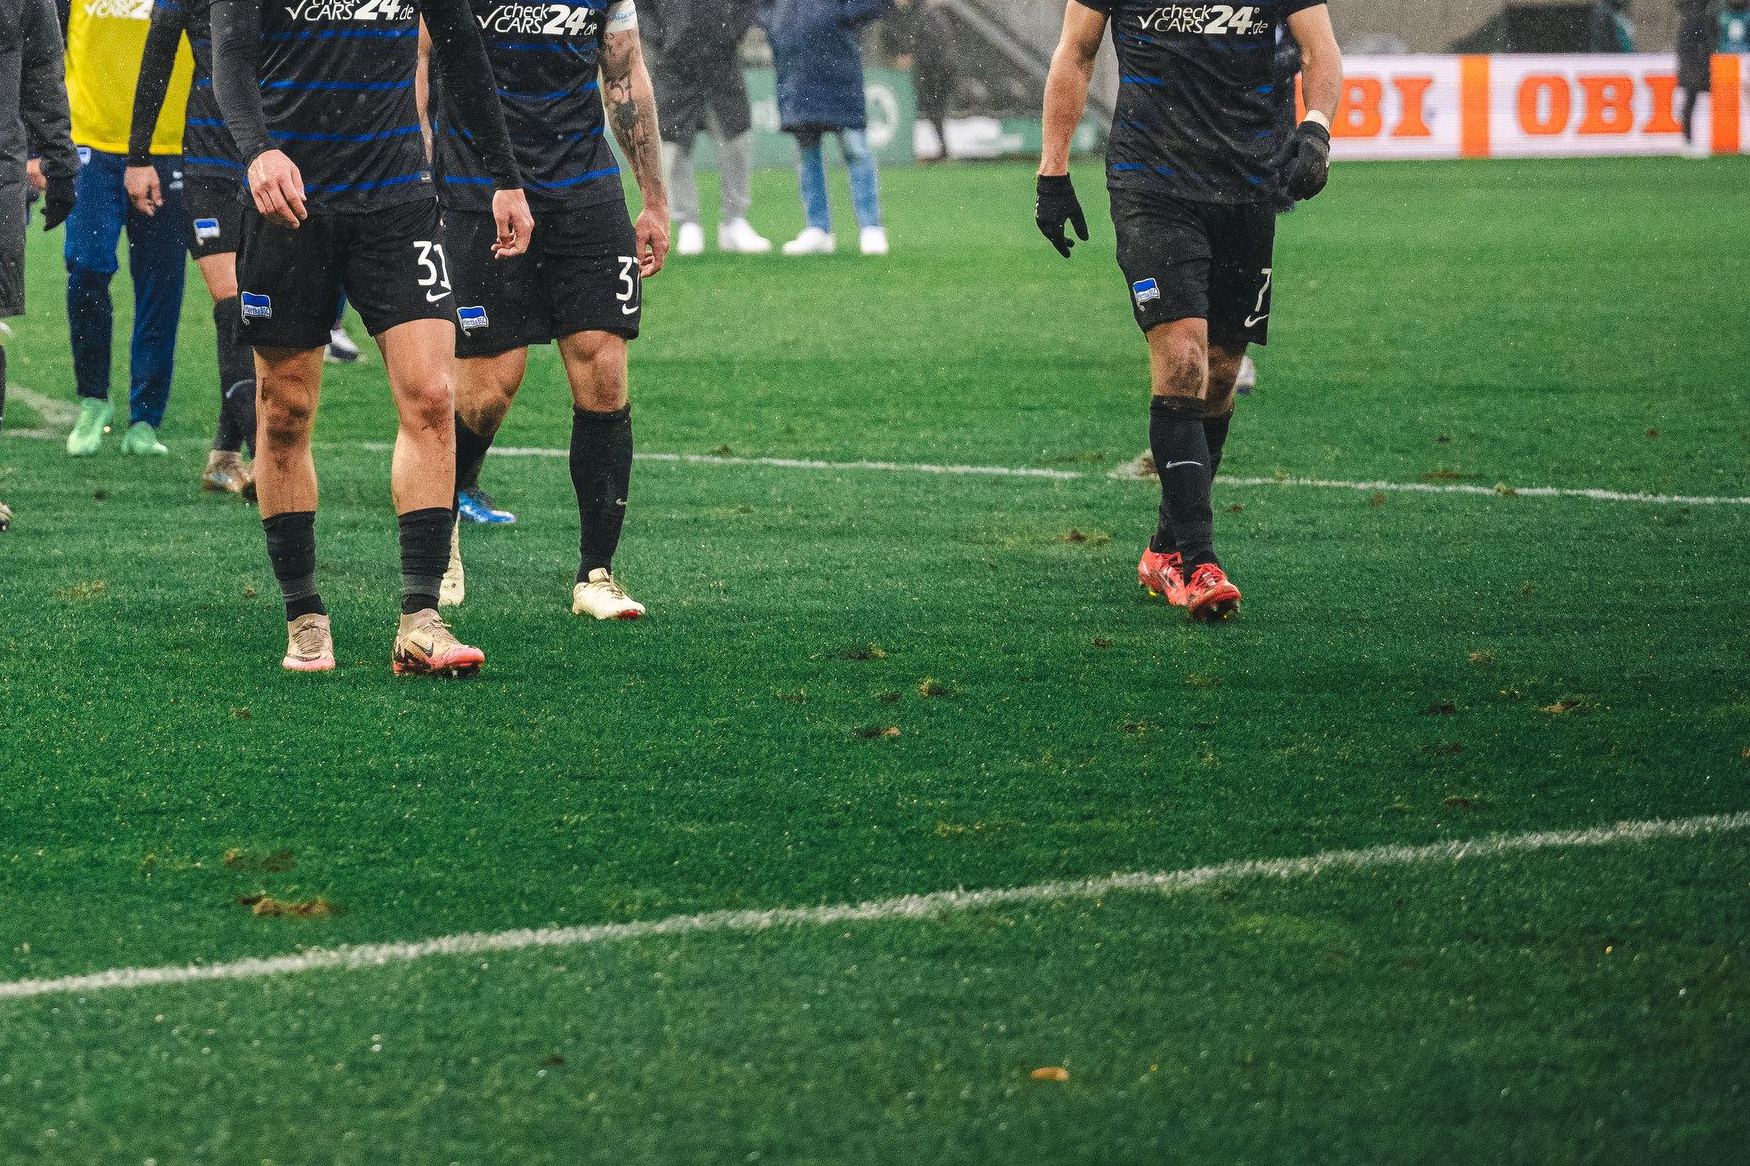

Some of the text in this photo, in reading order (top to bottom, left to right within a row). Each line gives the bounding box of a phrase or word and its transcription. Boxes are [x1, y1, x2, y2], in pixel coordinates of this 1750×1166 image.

[304, 4, 355, 21] CARS
[503, 2, 549, 20] check
[1161, 3, 1213, 20] check
[494, 17, 543, 34] CARS
[1154, 18, 1205, 34] CARS
[1516, 75, 1680, 135] OBI
[412, 240, 452, 291] 31
[1254, 267, 1272, 312] 7
